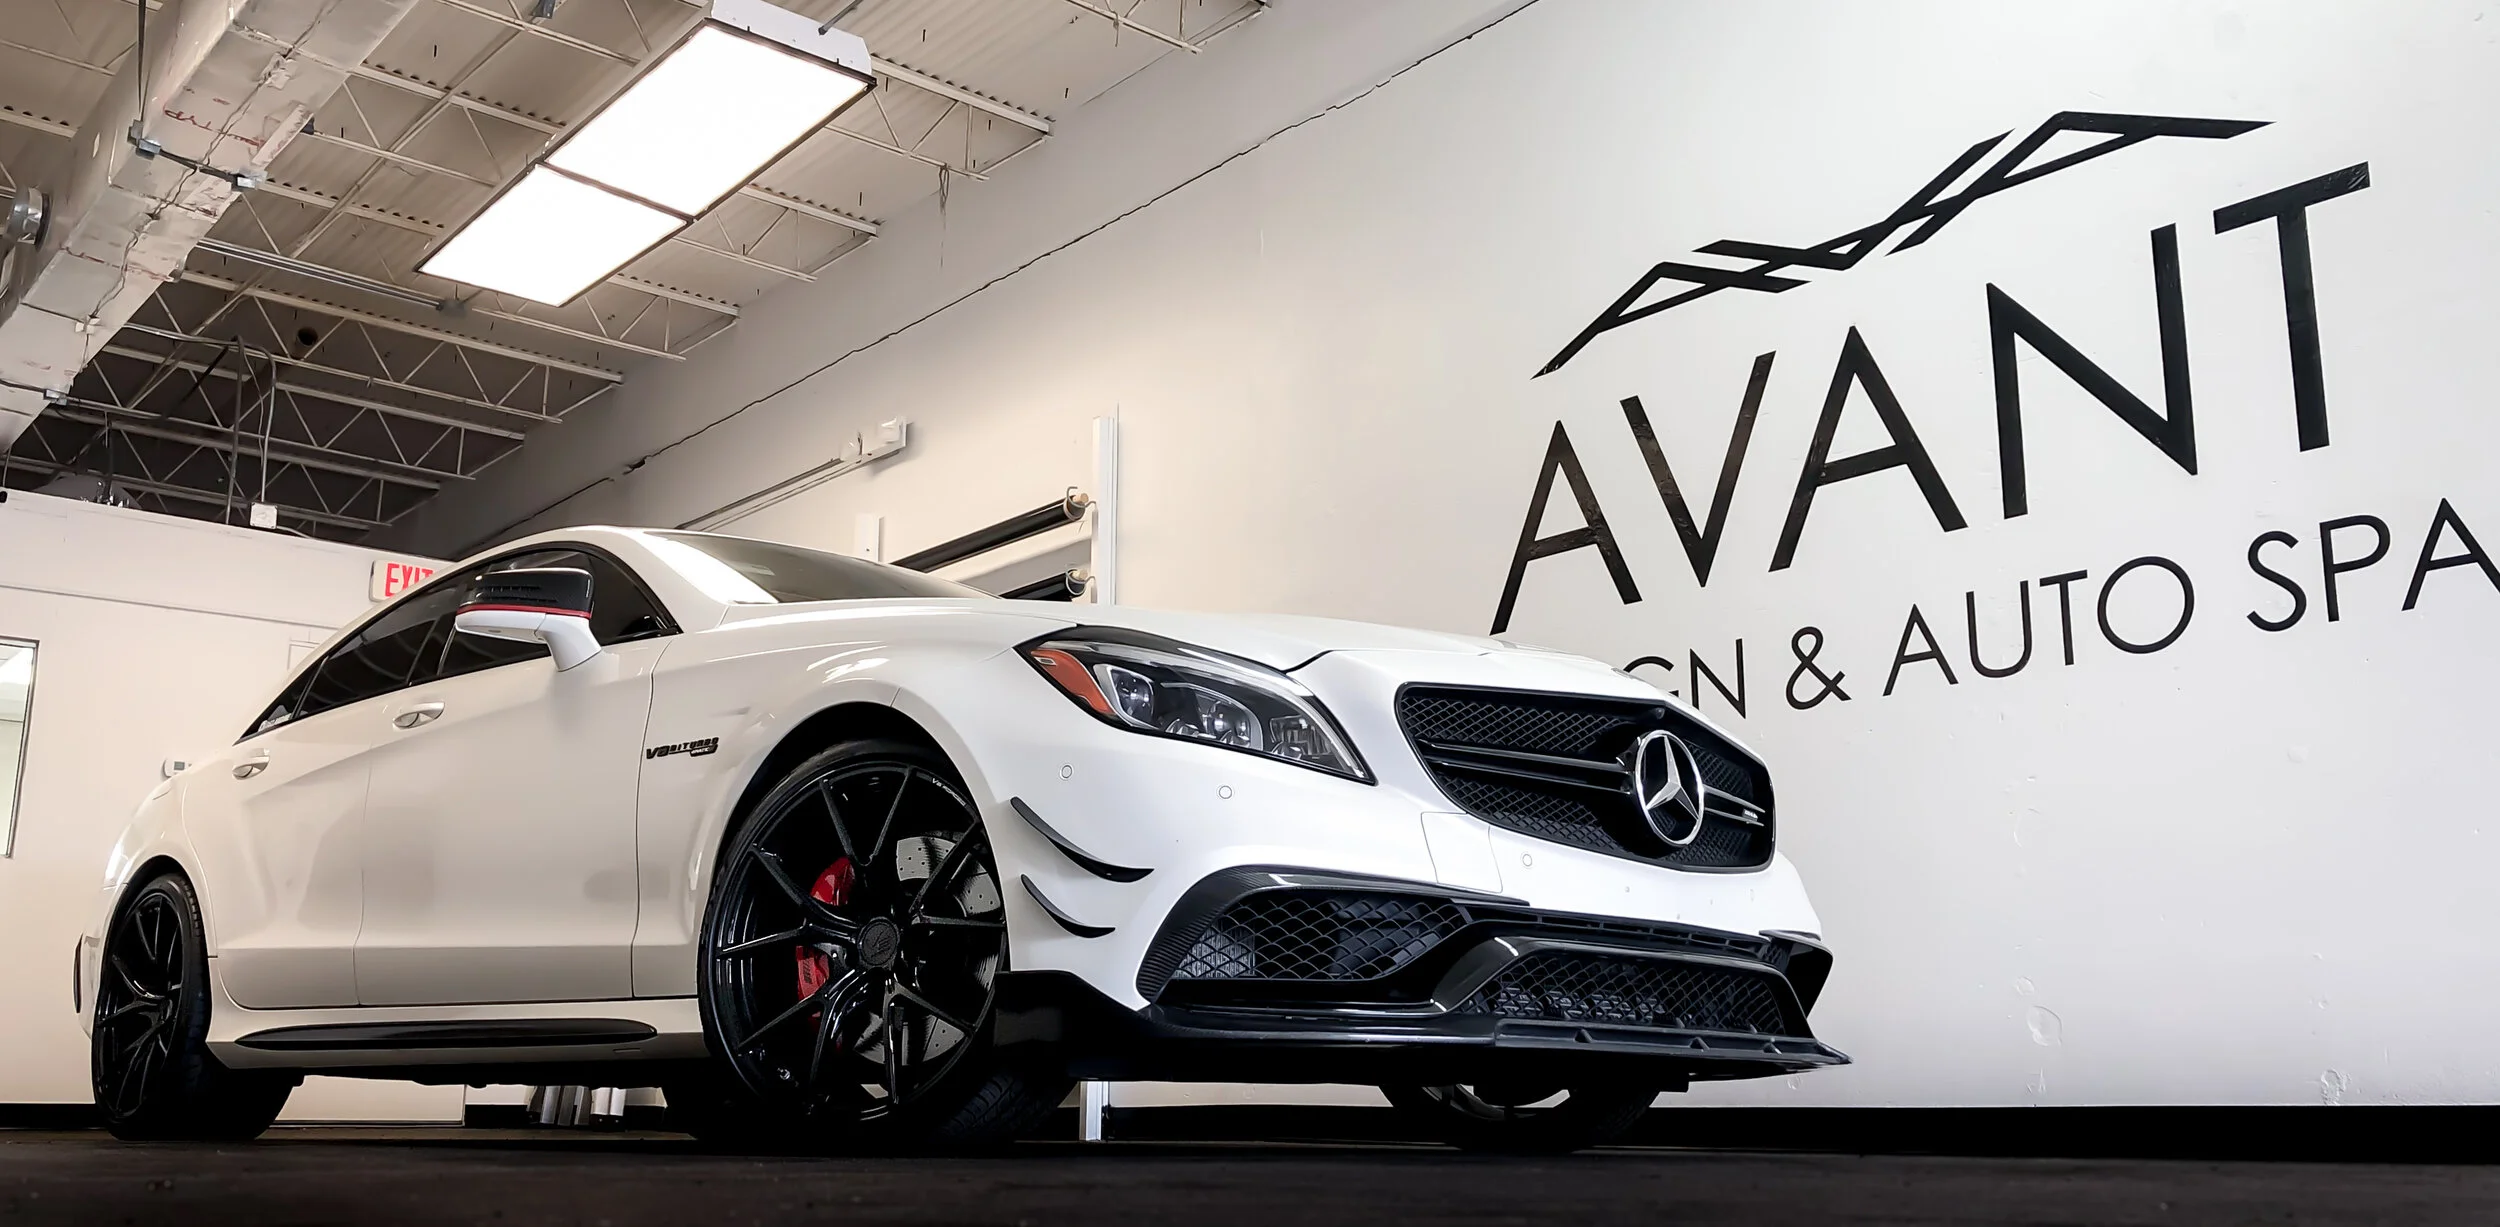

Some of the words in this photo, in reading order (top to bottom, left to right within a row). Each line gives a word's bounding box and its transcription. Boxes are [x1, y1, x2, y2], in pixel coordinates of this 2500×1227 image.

[1489, 161, 2371, 637] AVANT
[385, 562, 434, 597] EX
[1785, 626, 1852, 711] &
[1882, 556, 2195, 697] AUTO
[2246, 497, 2500, 632] SPA
